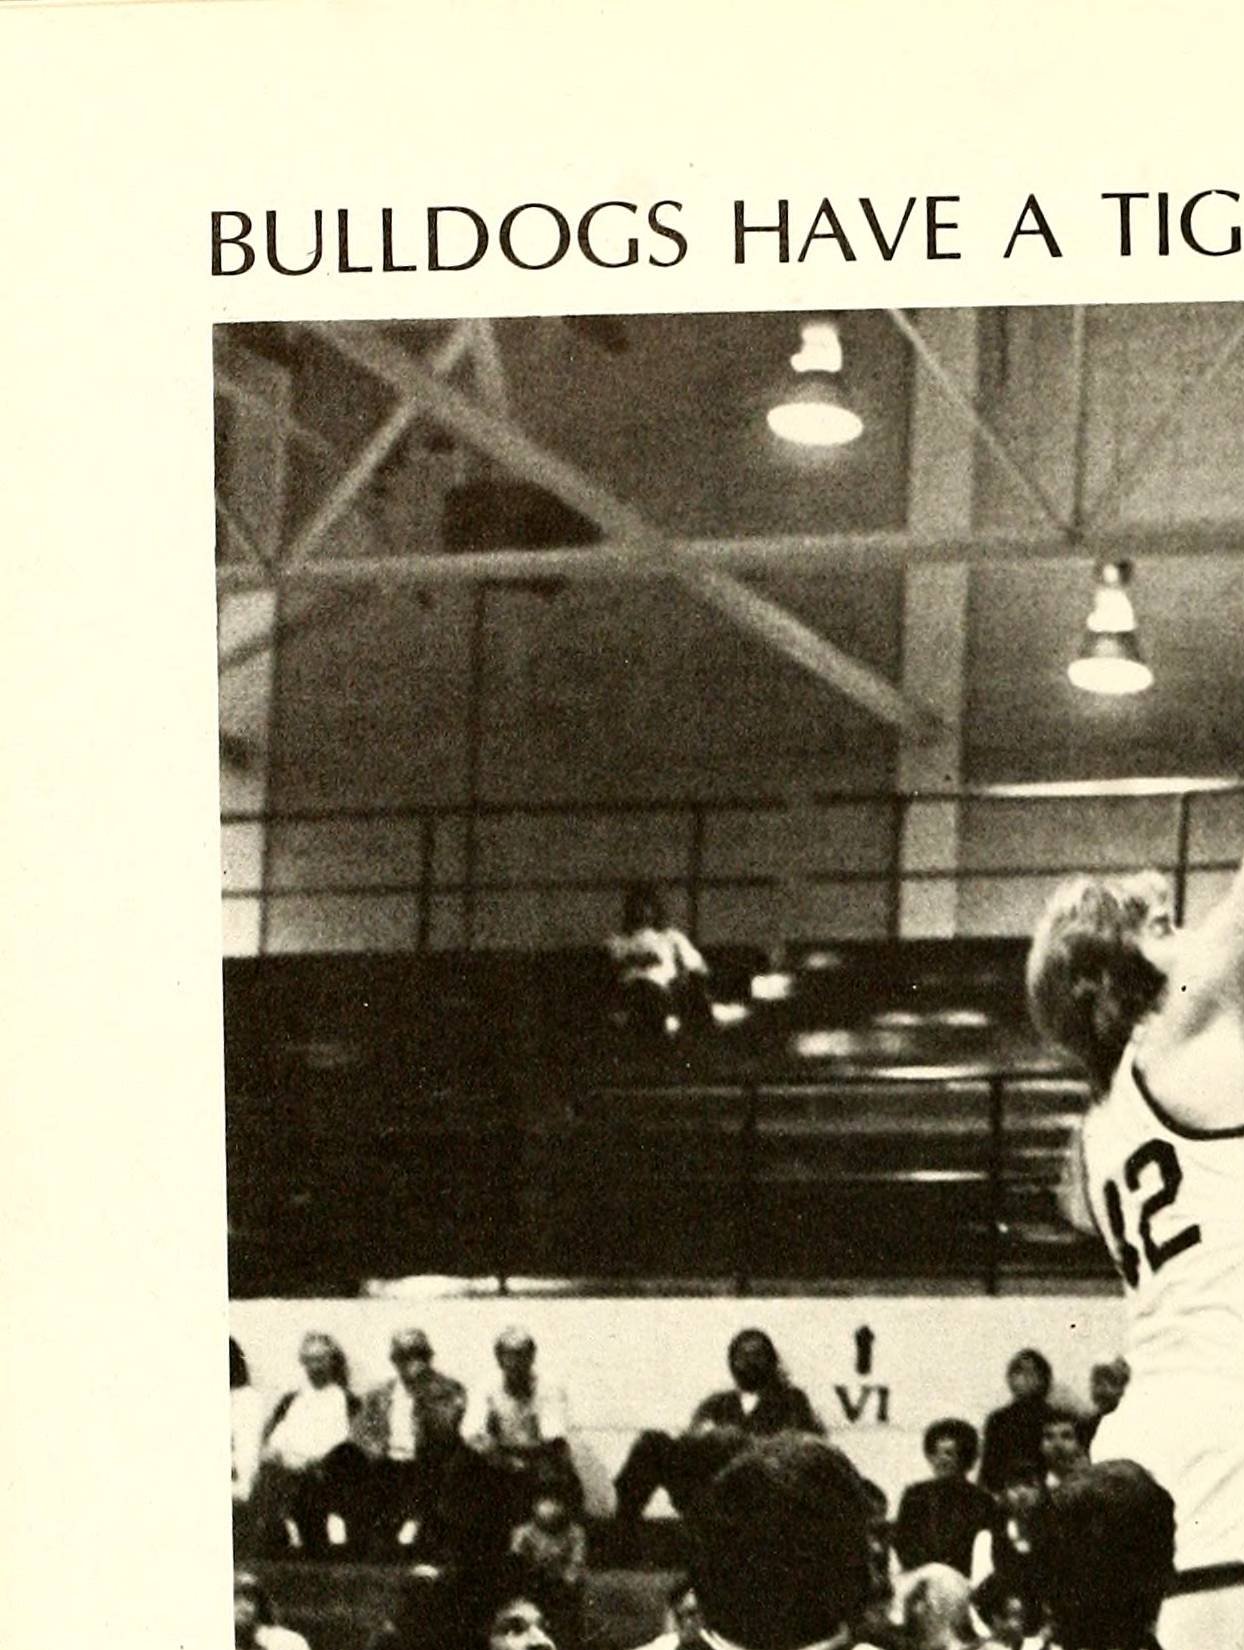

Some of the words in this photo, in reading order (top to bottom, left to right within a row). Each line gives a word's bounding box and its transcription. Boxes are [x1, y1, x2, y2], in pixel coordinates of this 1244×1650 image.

[211, 200, 688, 276] BULLDOGS
[734, 195, 962, 264] HAVE
[1003, 193, 1063, 259] A
[834, 1384, 889, 1424] VI
